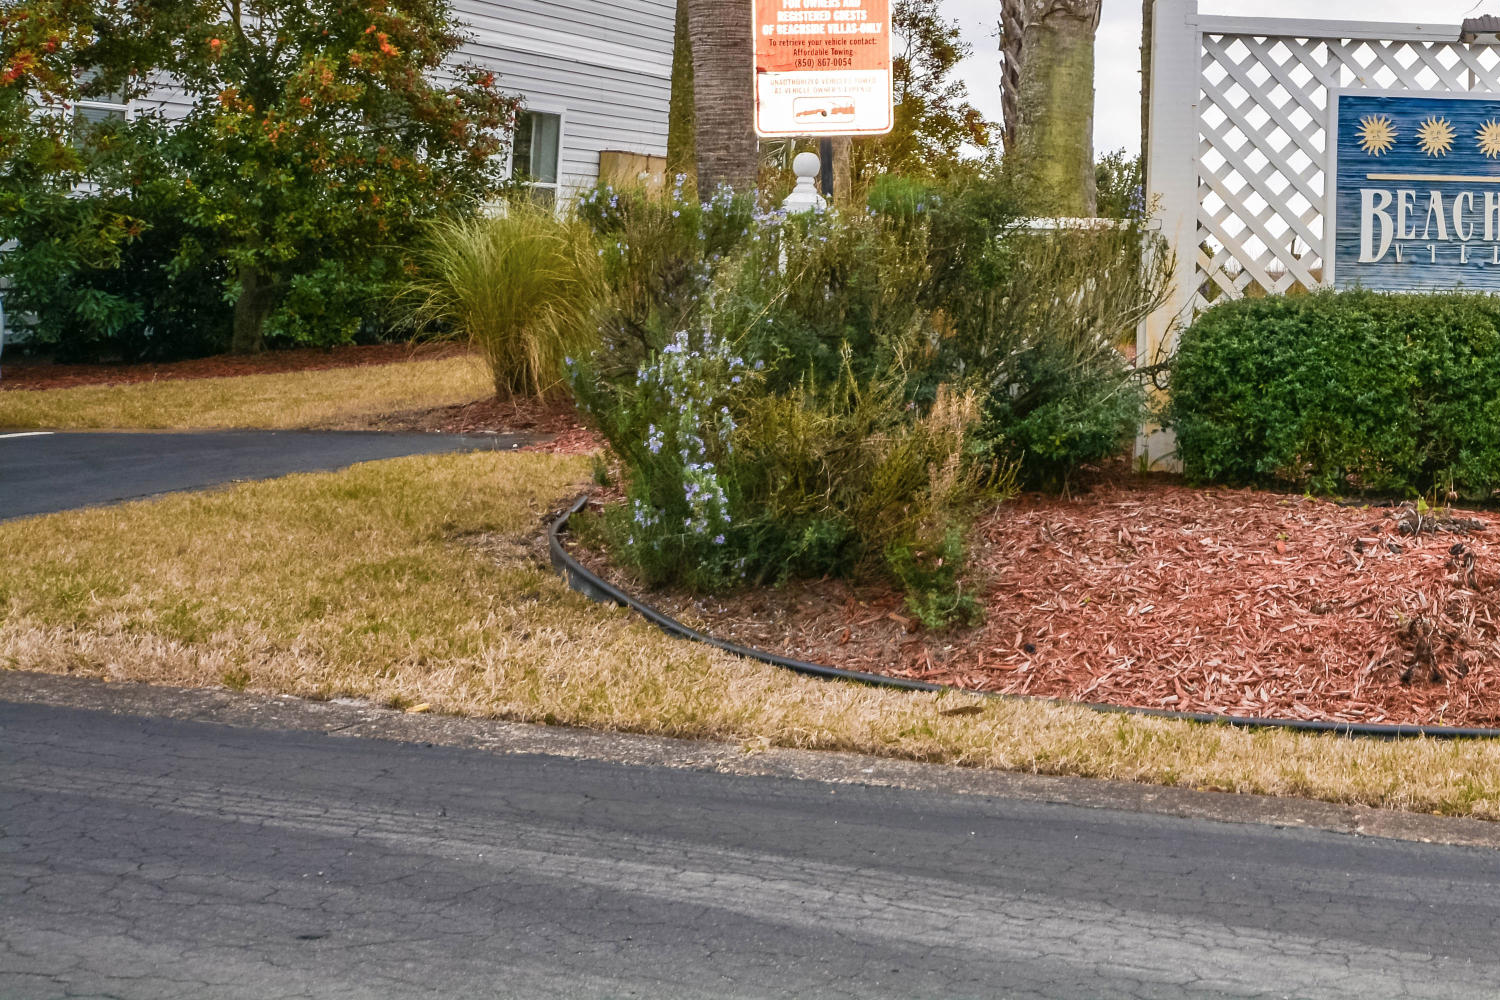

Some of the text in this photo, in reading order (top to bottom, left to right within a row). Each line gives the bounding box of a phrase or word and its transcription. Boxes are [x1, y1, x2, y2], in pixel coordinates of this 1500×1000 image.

[777, 10, 867, 22] REGISTERED GUESTS
[762, 24, 775, 36] OF
[776, 23, 825, 36] BEACHSIDE
[769, 38, 777, 46] To
[779, 38, 806, 46] retrieve
[807, 39, 822, 47] your
[824, 38, 847, 46] vehicle
[793, 47, 853, 56] Affordable Towing
[794, 58, 852, 68] (850) 867-0054
[844, 85, 872, 93] EPENE
